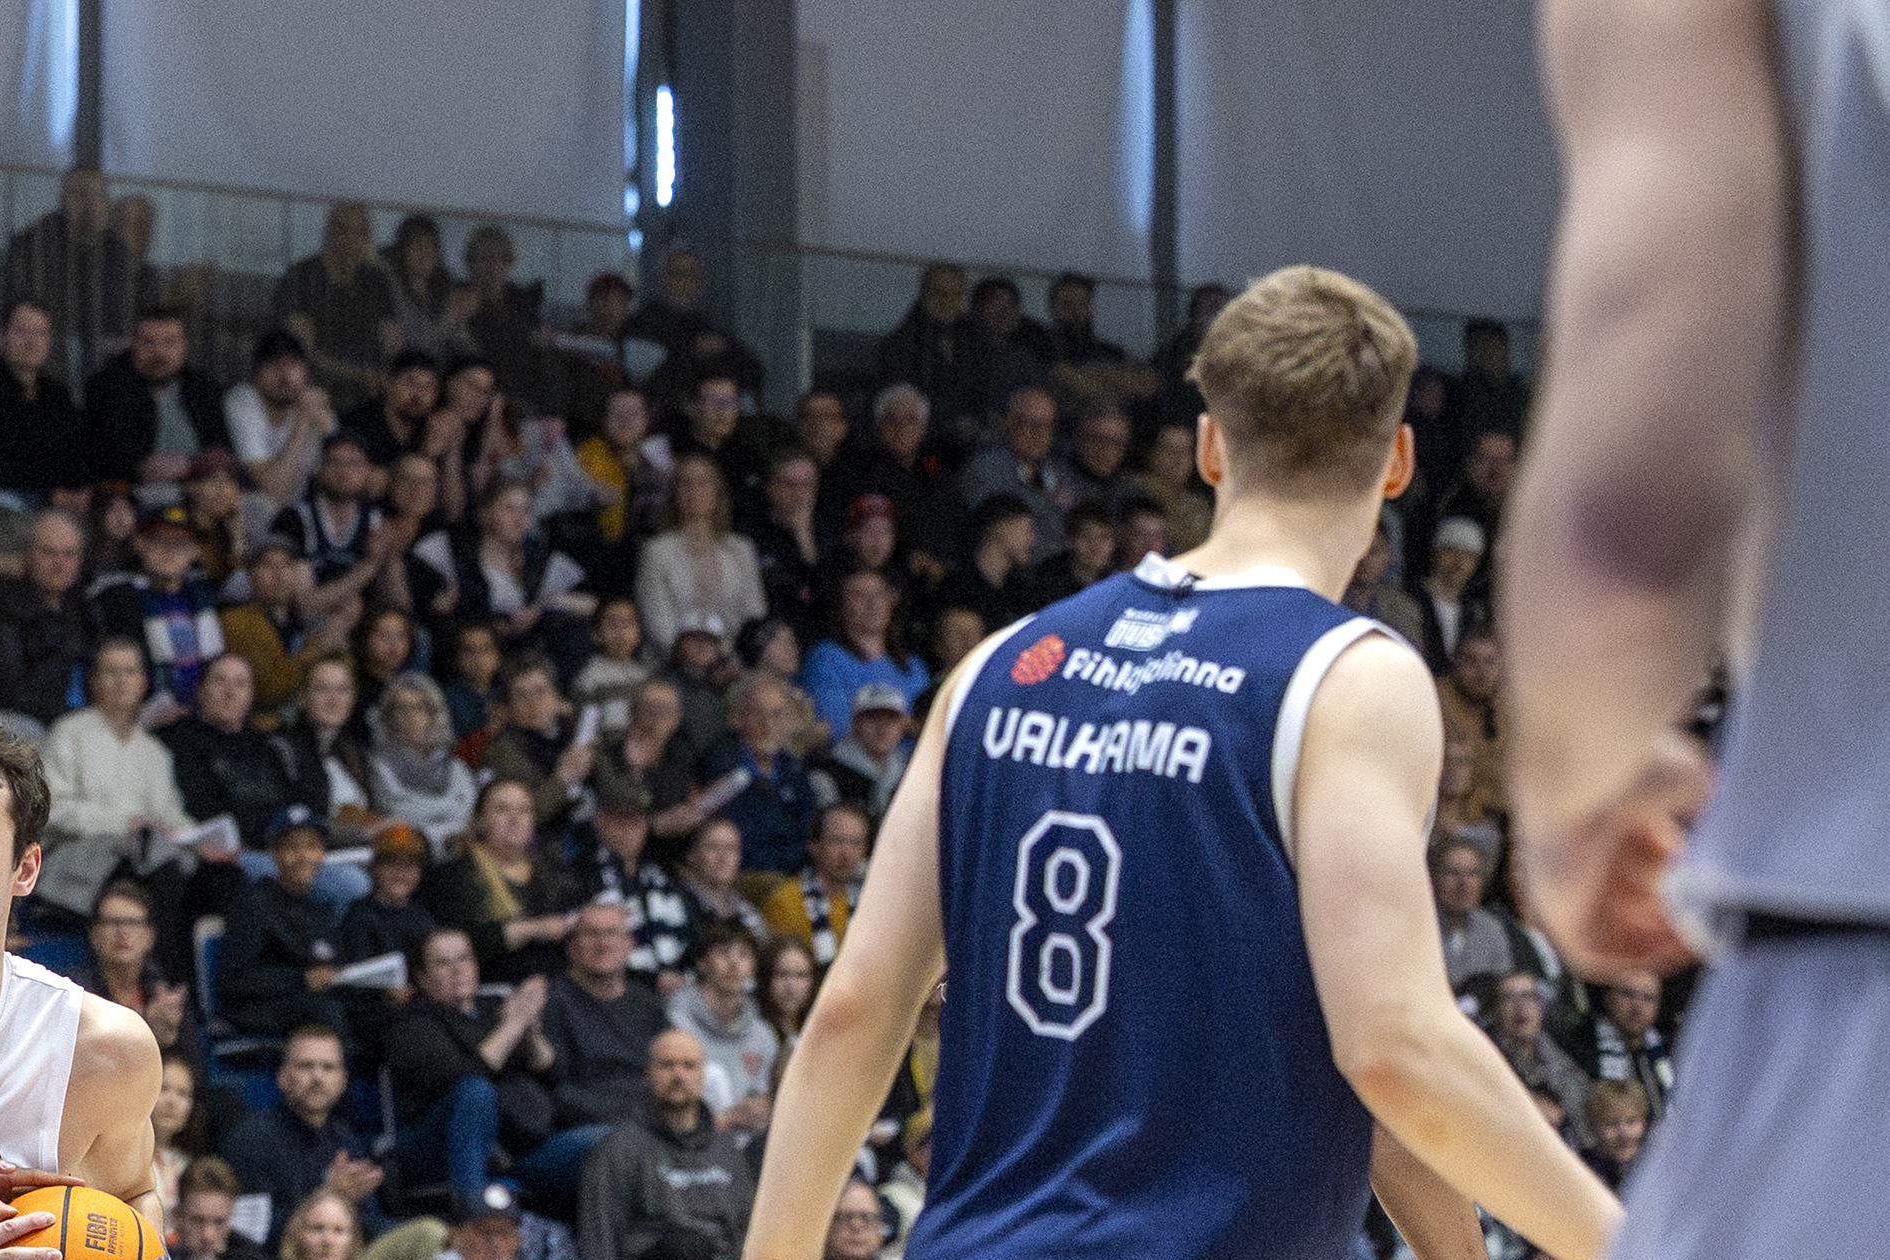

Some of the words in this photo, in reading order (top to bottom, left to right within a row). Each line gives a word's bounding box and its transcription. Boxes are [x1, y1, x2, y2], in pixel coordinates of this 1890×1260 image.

[1006, 809, 1123, 1042] 8
[84, 1212, 108, 1252] FIBA
[107, 1217, 119, 1255] APPROVED
